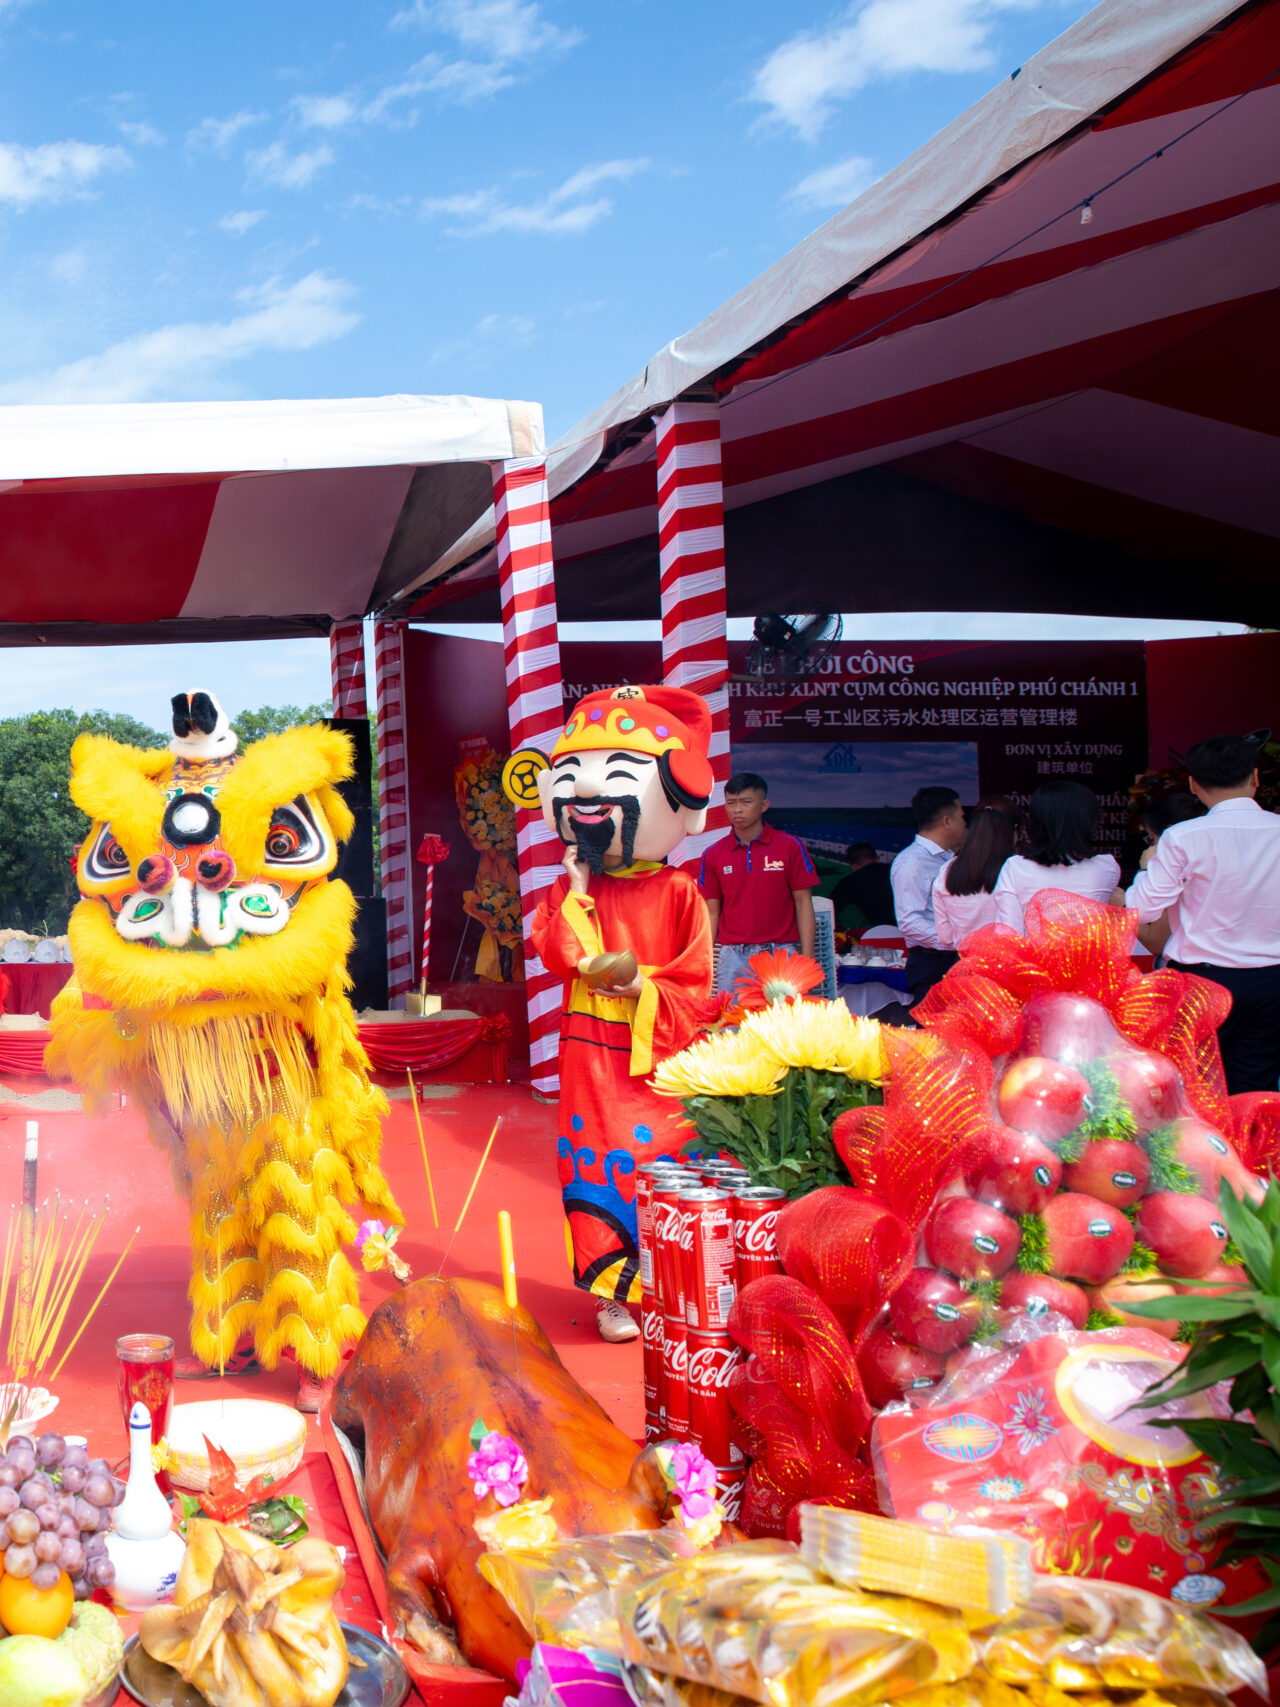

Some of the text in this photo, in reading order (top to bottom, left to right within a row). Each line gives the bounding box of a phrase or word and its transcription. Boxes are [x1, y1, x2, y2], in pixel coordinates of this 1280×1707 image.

[847, 650, 915, 675] CÔNG
[789, 682, 841, 698] XLNT
[843, 681, 886, 701] CỤM
[889, 677, 940, 697] CÔNG
[943, 676, 1016, 701] NGHIỆP
[1018, 676, 1057, 697] PHÚ
[1061, 676, 1127, 697] CHÁNH
[1130, 681, 1138, 696] 1
[743, 708, 1078, 728] 富正一号工业区污水处理区运营管理楼
[1004, 741, 1123, 758] ĐƠN VỊ XÂY DỰNG
[1036, 761, 1094, 775] 建筑单位
